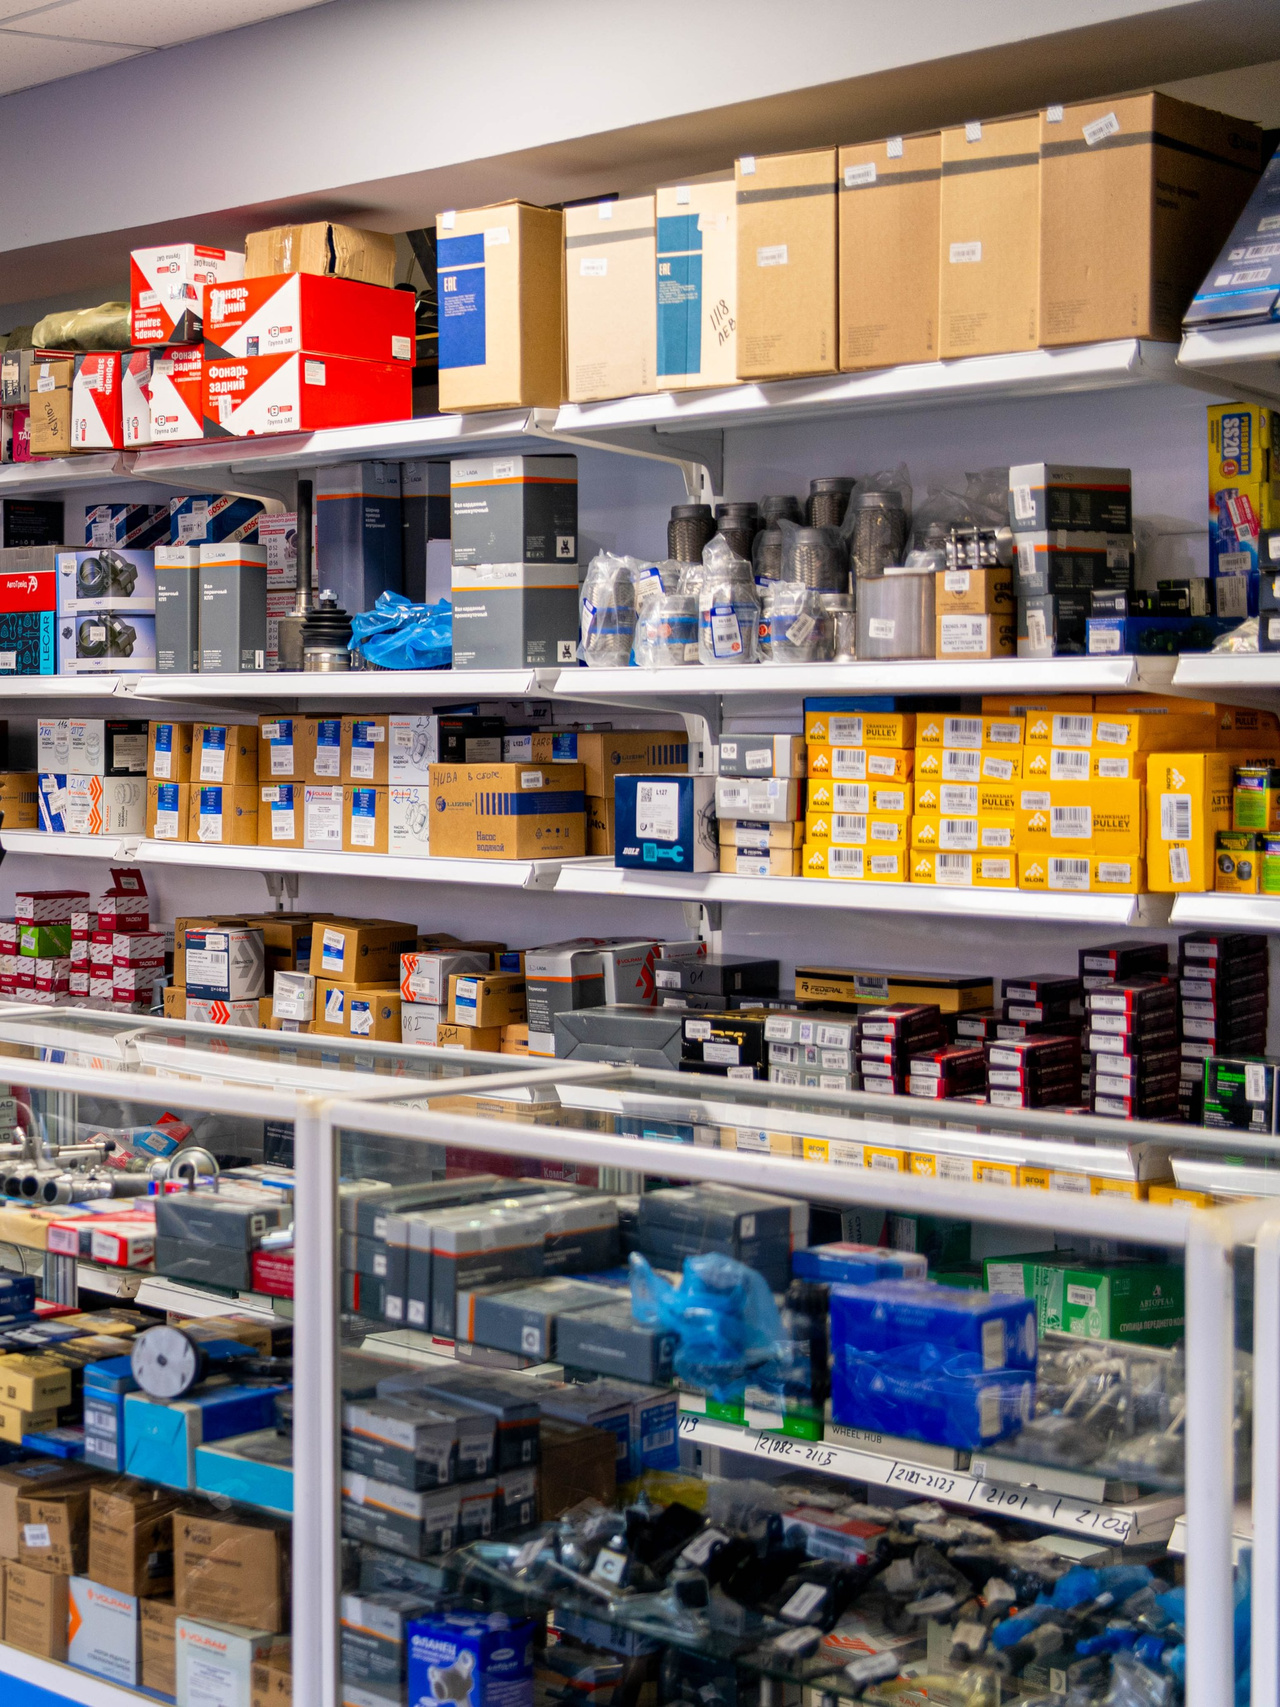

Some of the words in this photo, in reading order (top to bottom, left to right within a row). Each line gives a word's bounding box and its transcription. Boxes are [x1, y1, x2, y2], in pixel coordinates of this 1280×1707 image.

[709, 299, 730, 331] 1118
[135, 318, 161, 331] задний
[135, 331, 164, 339] Фонарь
[268, 339, 284, 347] Группа
[172, 351, 201, 361] Фонарь
[174, 361, 202, 372] задний
[106, 358, 114, 396] Фонарь
[209, 366, 248, 379] Фонарь
[209, 379, 245, 393] задний
[267, 419, 283, 427] Группа
[1222, 416, 1240, 458] SS20
[207, 498, 229, 517] BOSCH
[463, 501, 487, 509] карданный
[7, 580, 27, 589] АвтоТрейд
[866, 729, 897, 737] PULLEY
[433, 771, 458, 787] НИВА
[982, 799, 1015, 807] PULLEY
[1093, 820, 1131, 829] PULLEY
[476, 831, 497, 841] Насос
[476, 842, 505, 852] водяной
[810, 985, 843, 995] FEDERAL
[1119, 1321, 1143, 1333] СТУПИЦА
[1143, 1318, 1172, 1332] ПЕРЕДНЕГО
[831, 1426, 861, 1440] WHEEL
[863, 1432, 883, 1444] HUB
[988, 1488, 1028, 1511] 2101
[45, 1515, 63, 1524] VOLT
[191, 1534, 212, 1545] VOLT
[95, 1592, 132, 1611] VOLRAM
[189, 1633, 228, 1651] VOLRAM
